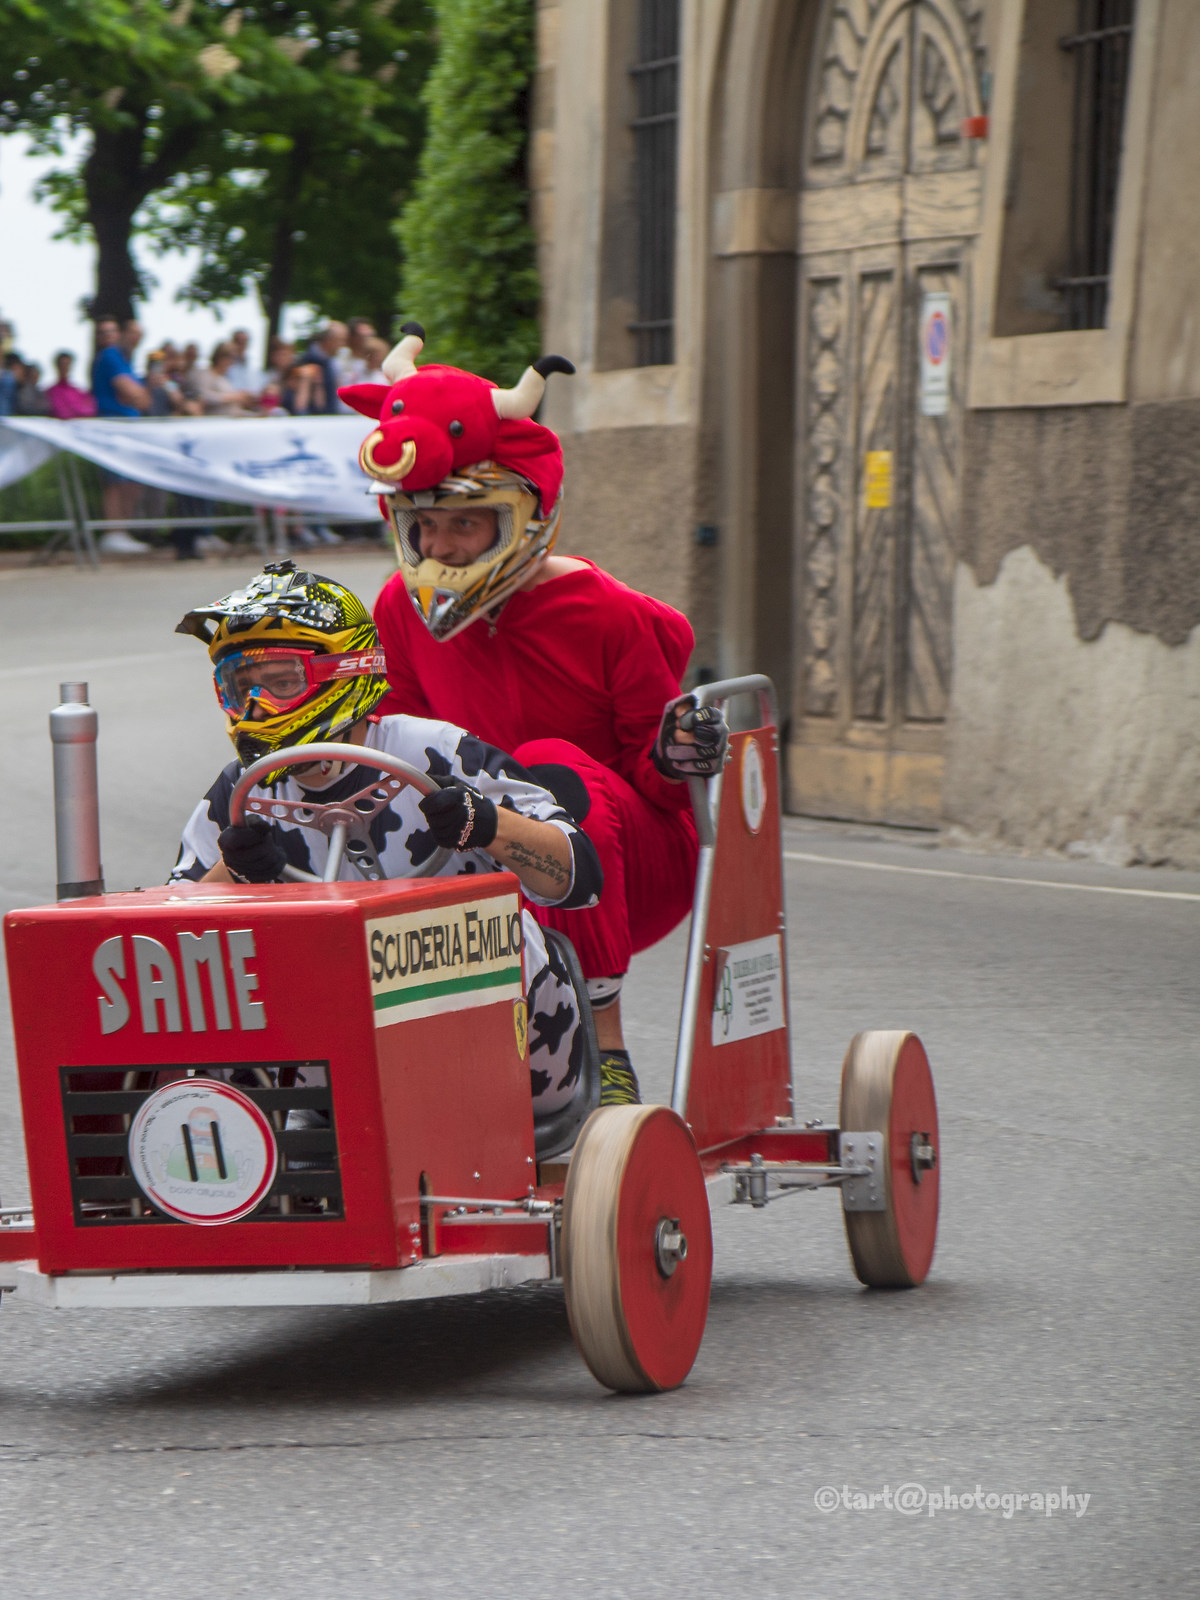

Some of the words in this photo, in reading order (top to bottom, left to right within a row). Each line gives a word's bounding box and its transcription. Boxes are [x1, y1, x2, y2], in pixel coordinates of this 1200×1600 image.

[92, 928, 268, 1035] SAME
[371, 922, 464, 983] SCUDERIA
[465, 910, 523, 964] EMILIO
[181, 1121, 228, 1182] 11
